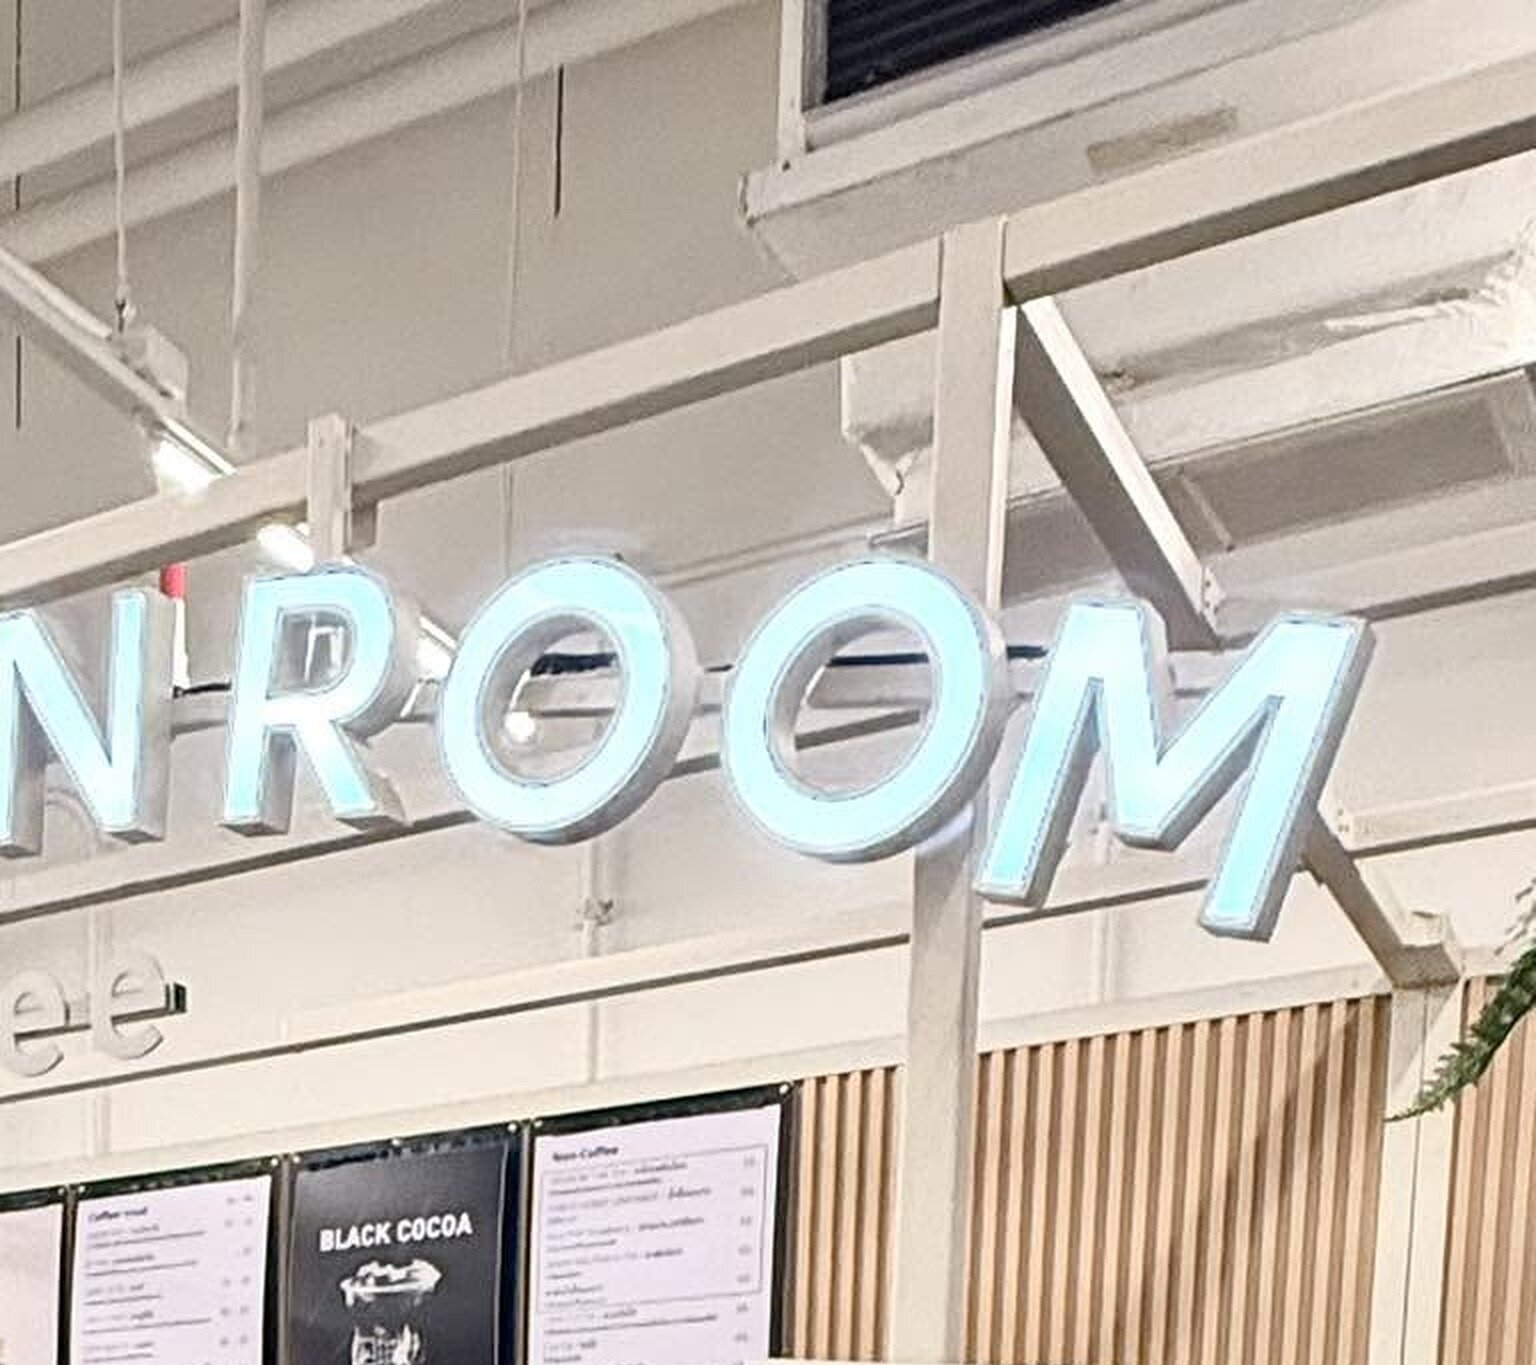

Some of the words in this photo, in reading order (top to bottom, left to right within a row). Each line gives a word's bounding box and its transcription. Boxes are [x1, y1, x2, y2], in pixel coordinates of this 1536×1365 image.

[221, 552, 1378, 942] ROOM
[320, 1221, 392, 1251] BLACK
[396, 1212, 473, 1243] COCOA
